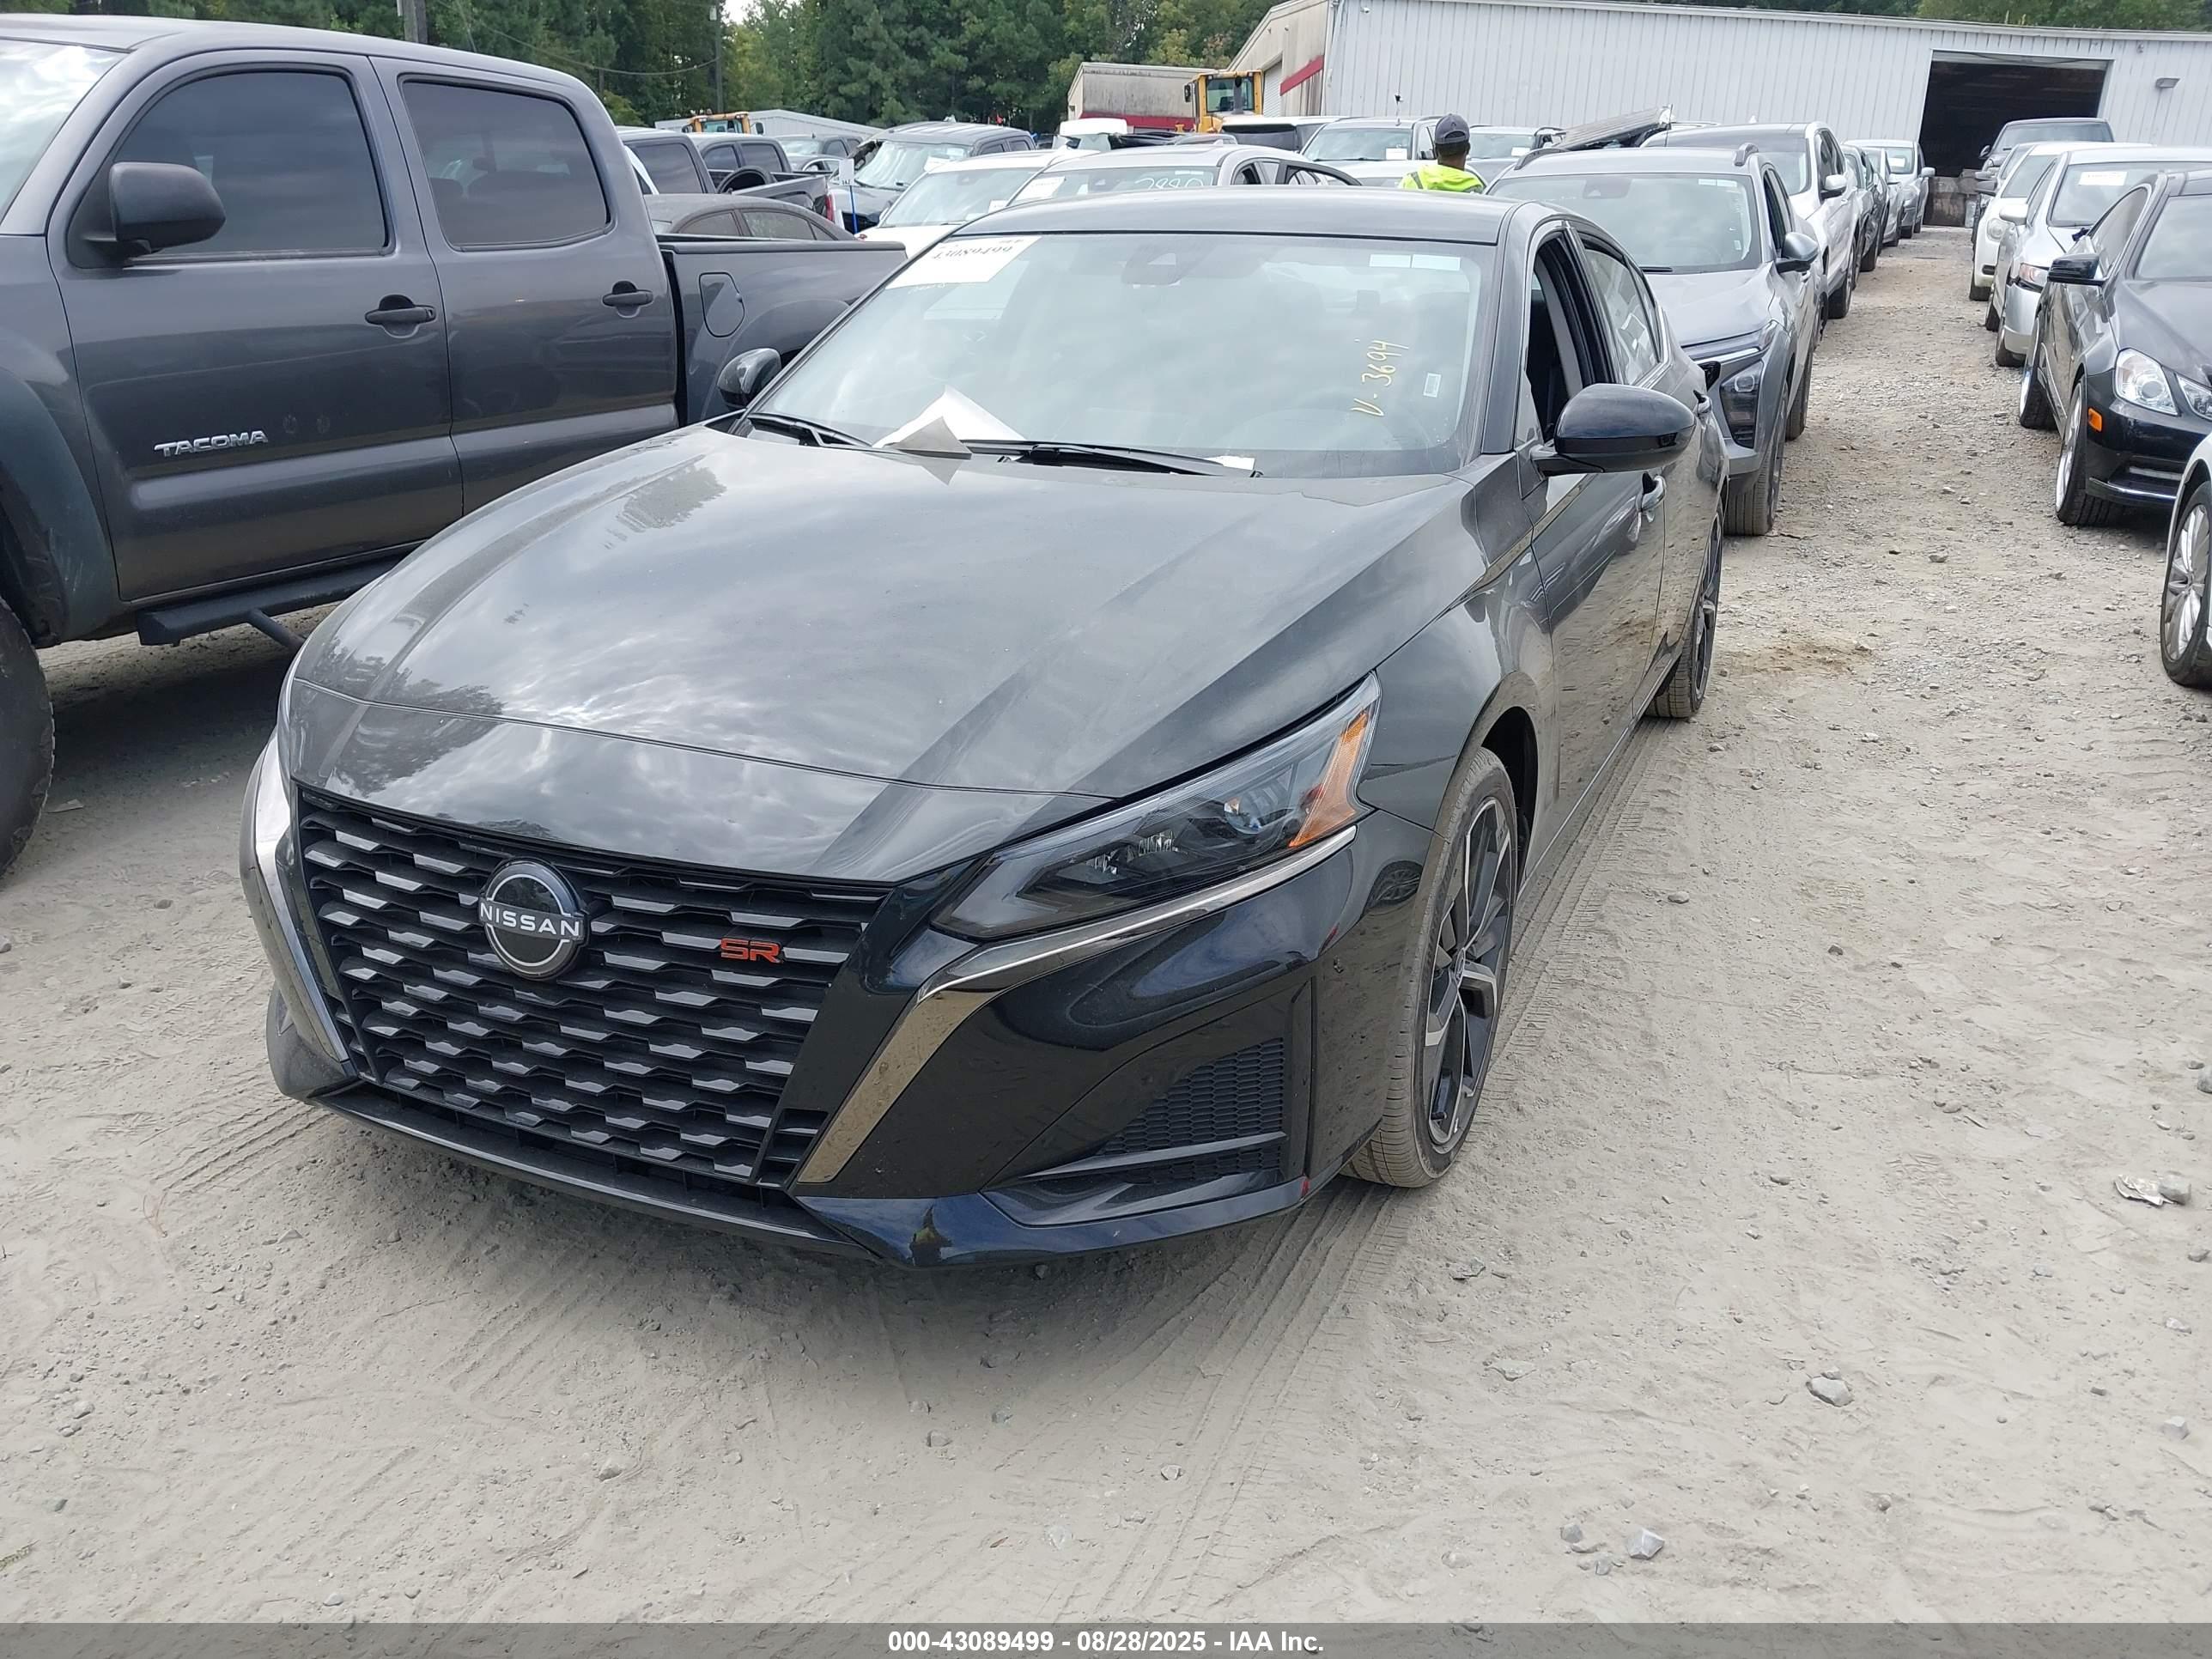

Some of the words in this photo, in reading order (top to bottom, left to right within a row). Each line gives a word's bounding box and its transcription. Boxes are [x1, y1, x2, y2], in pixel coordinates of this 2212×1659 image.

[154, 430, 268, 457] TACOMA
[479, 902, 580, 937] NISSAN
[720, 937, 784, 963] SR
